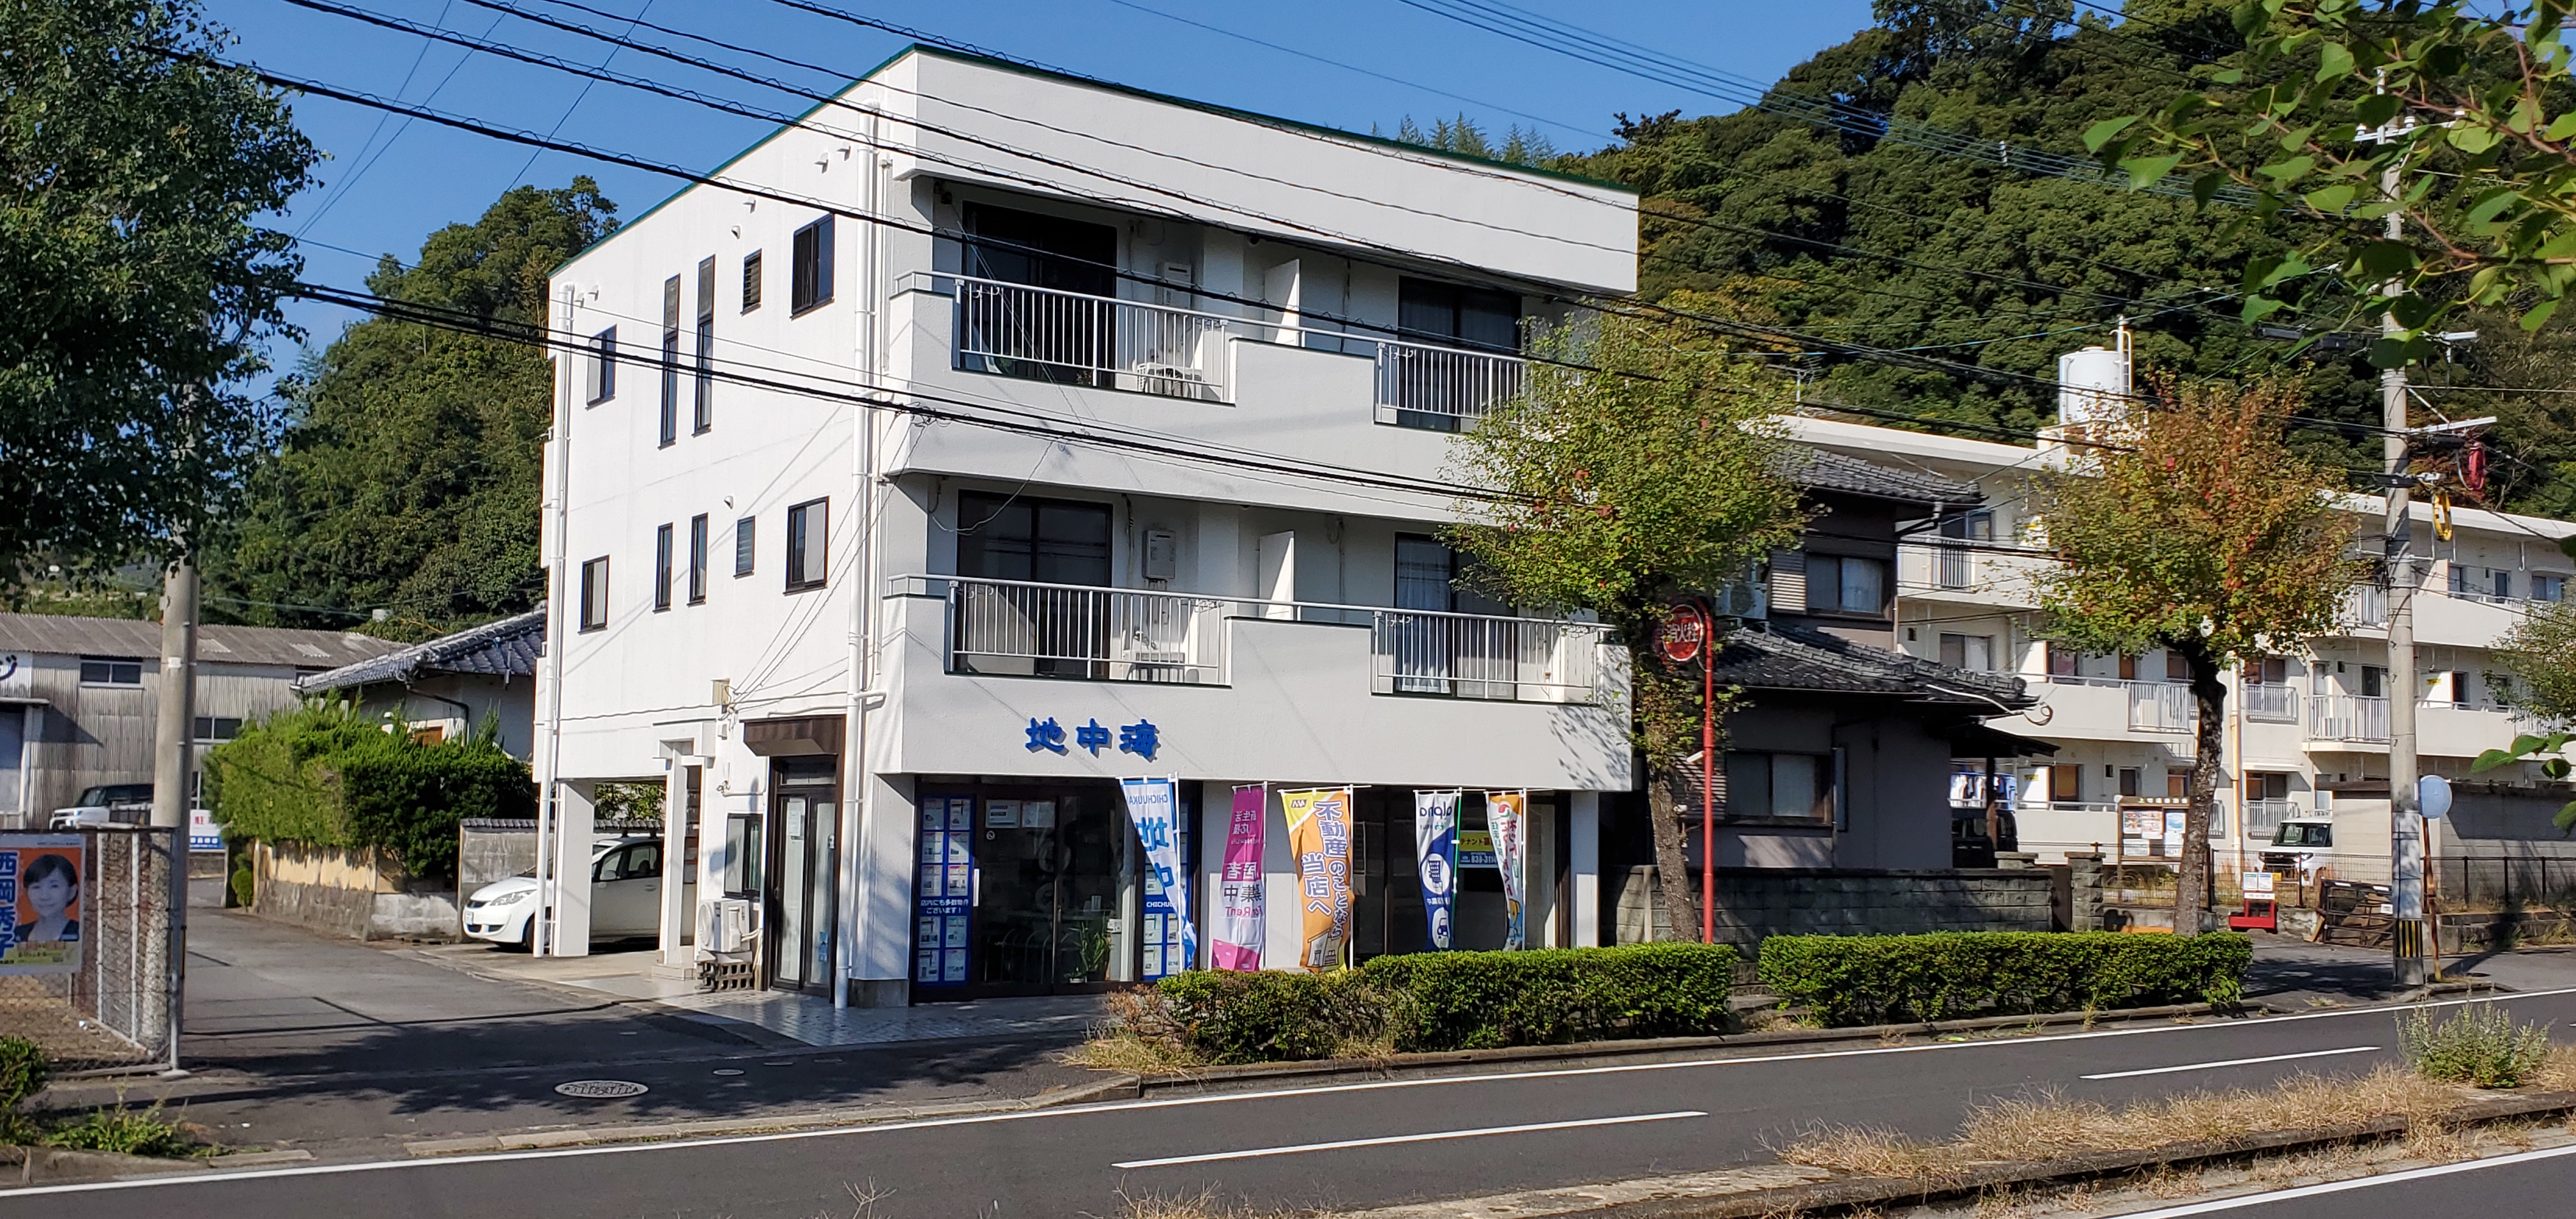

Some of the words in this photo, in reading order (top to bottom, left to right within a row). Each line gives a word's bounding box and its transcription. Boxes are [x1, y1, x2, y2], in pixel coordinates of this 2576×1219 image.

[1662, 622, 1699, 643] 消火栓
[1025, 717, 1158, 762] 地中海
[1301, 853, 1331, 916] 当店へ
[1314, 801, 1348, 940] 不動産のことなら
